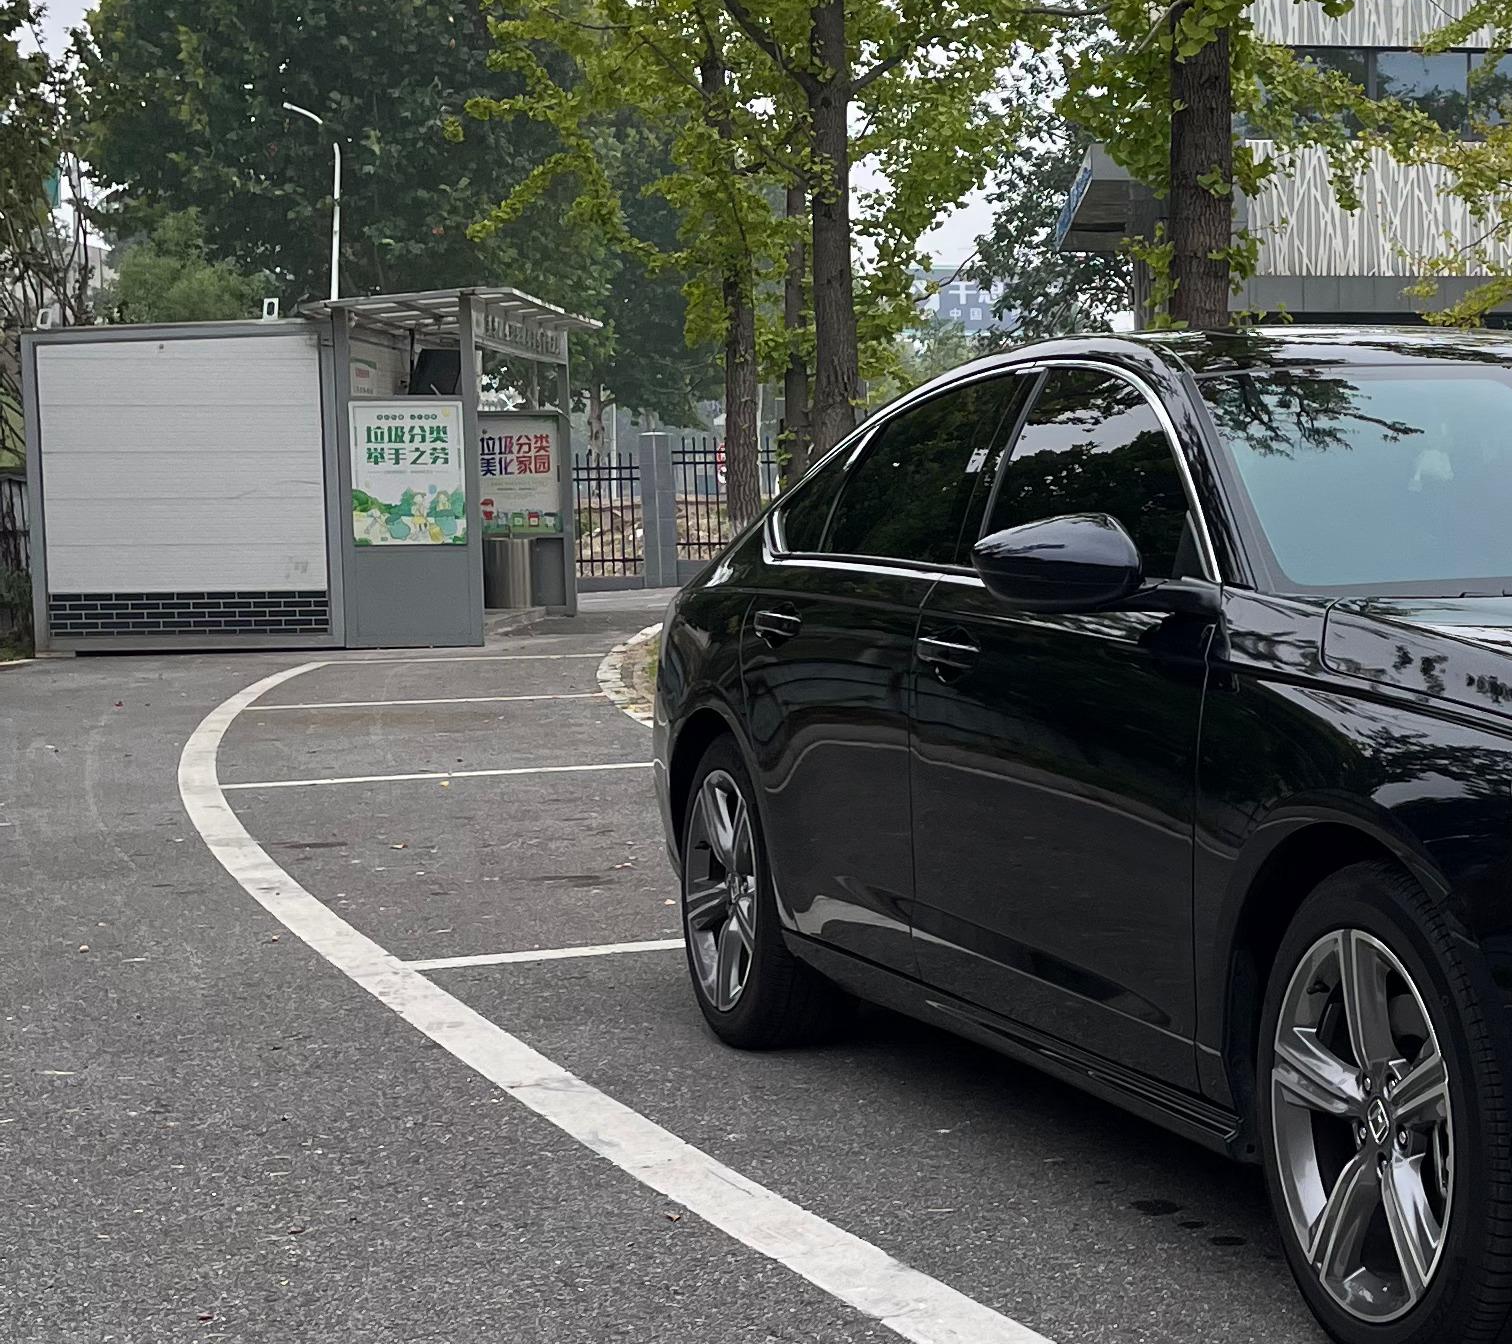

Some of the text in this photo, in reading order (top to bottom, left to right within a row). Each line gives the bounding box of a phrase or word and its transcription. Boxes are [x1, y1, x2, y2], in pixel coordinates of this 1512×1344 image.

[366, 425, 448, 444] 垃圾分类
[480, 434, 550, 456] 垃圾分类
[366, 447, 449, 465] 举手之劳
[480, 455, 551, 476] 美化家园
